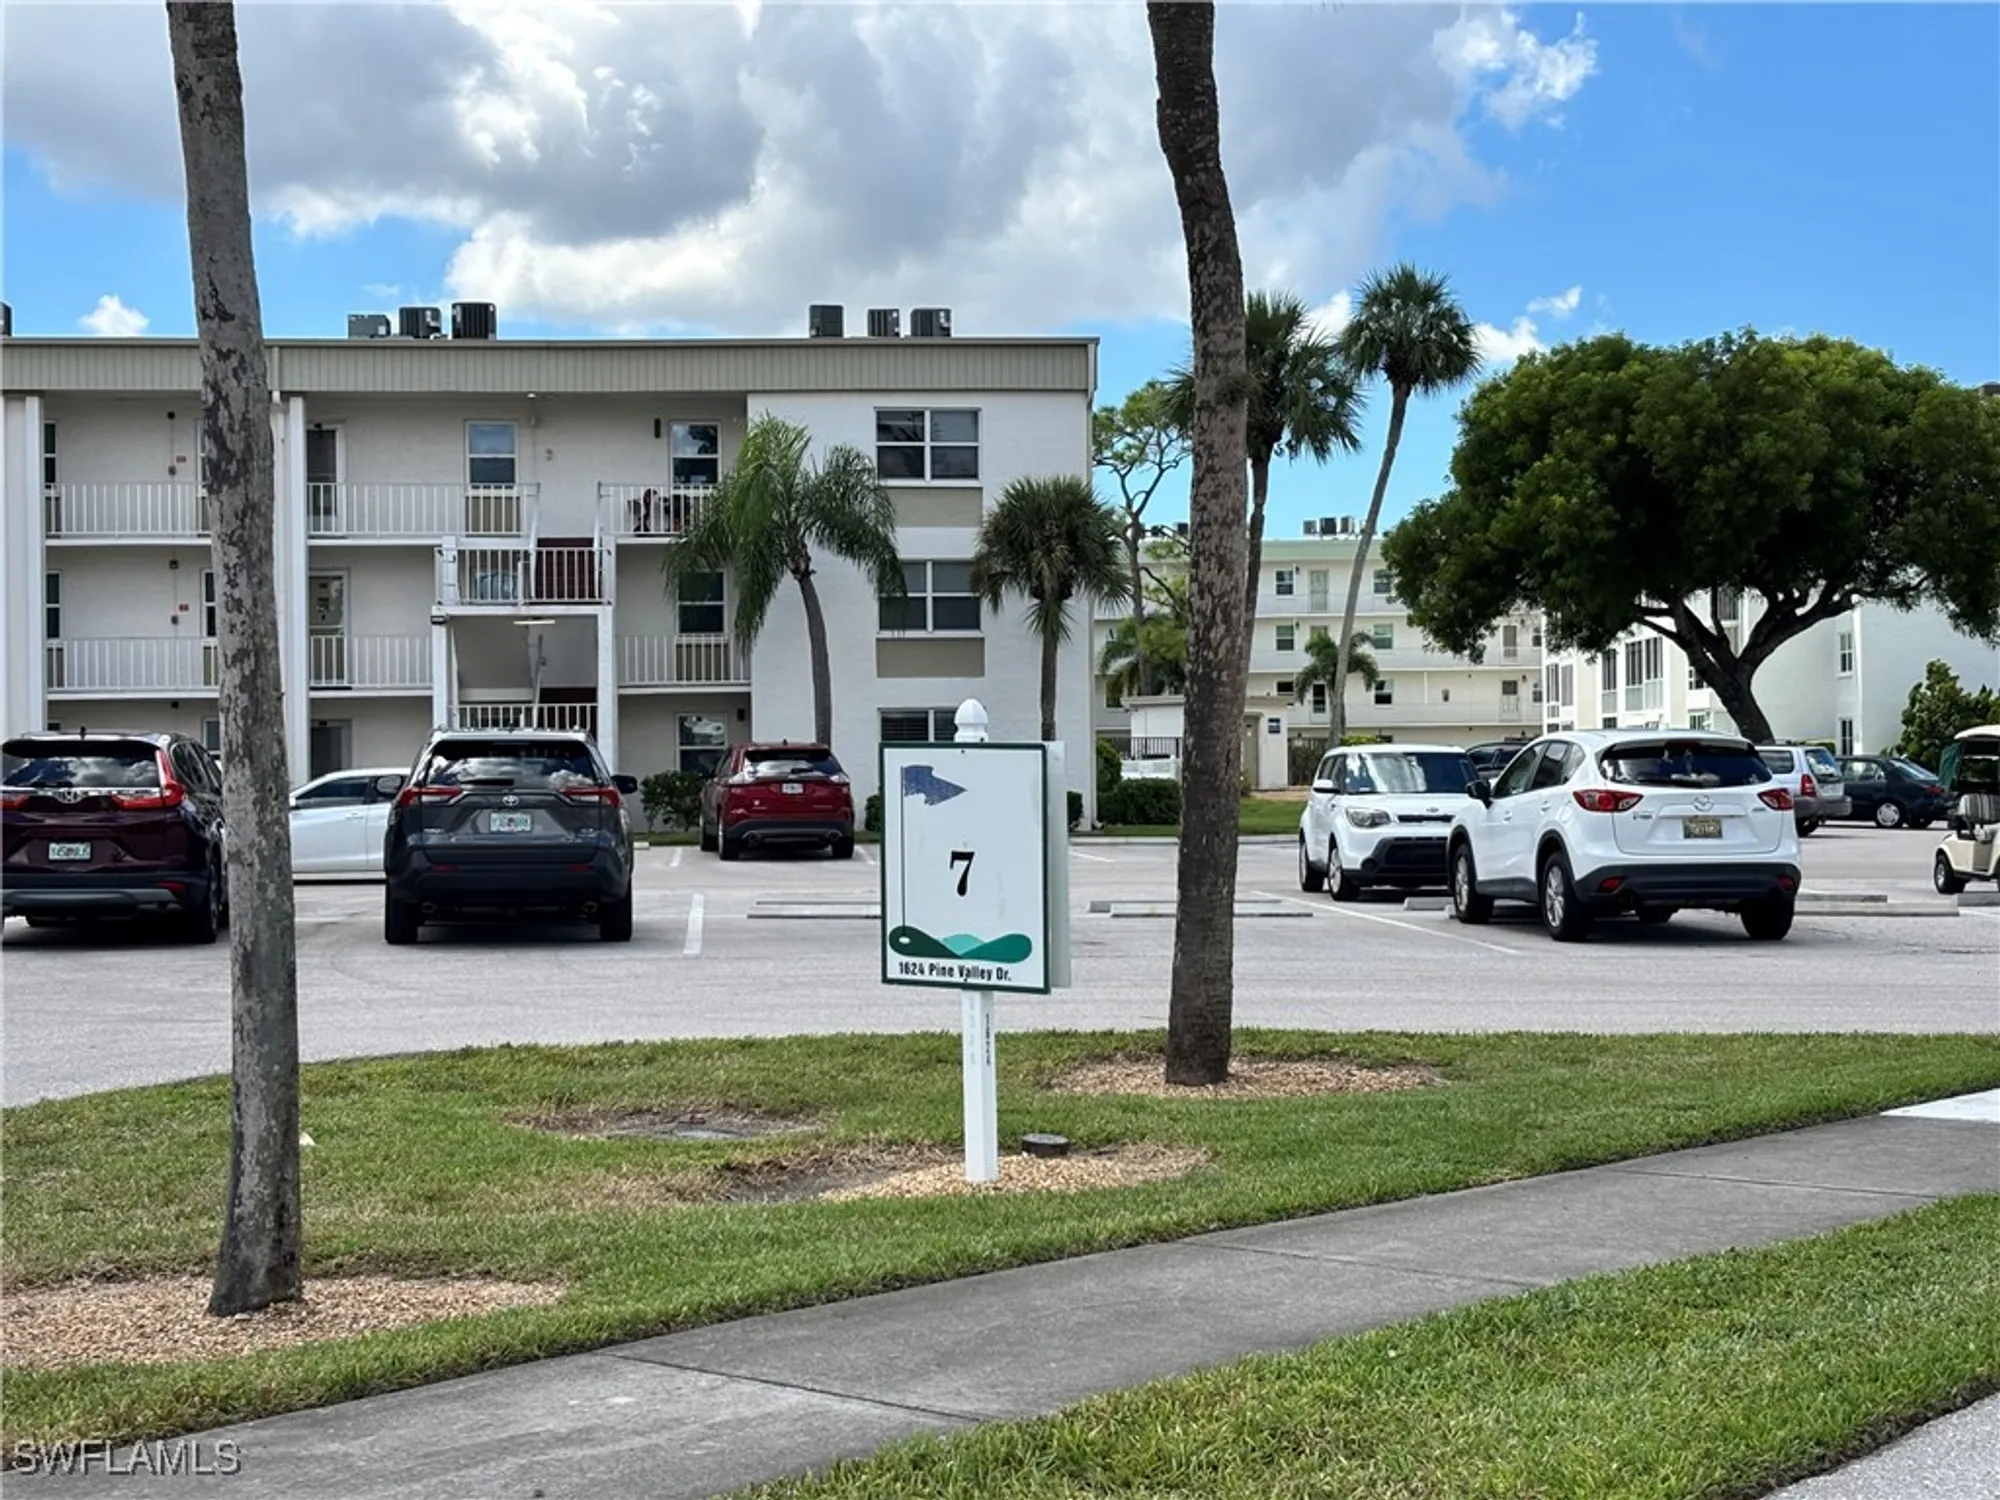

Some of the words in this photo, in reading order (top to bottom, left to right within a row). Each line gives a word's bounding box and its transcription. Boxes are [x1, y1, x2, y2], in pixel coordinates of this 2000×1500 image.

[950, 850, 975, 897] 7
[899, 961, 924, 976] 1624
[929, 962, 955, 978] Pine
[958, 964, 993, 982] Valley
[996, 966, 1012, 982] Dr.
